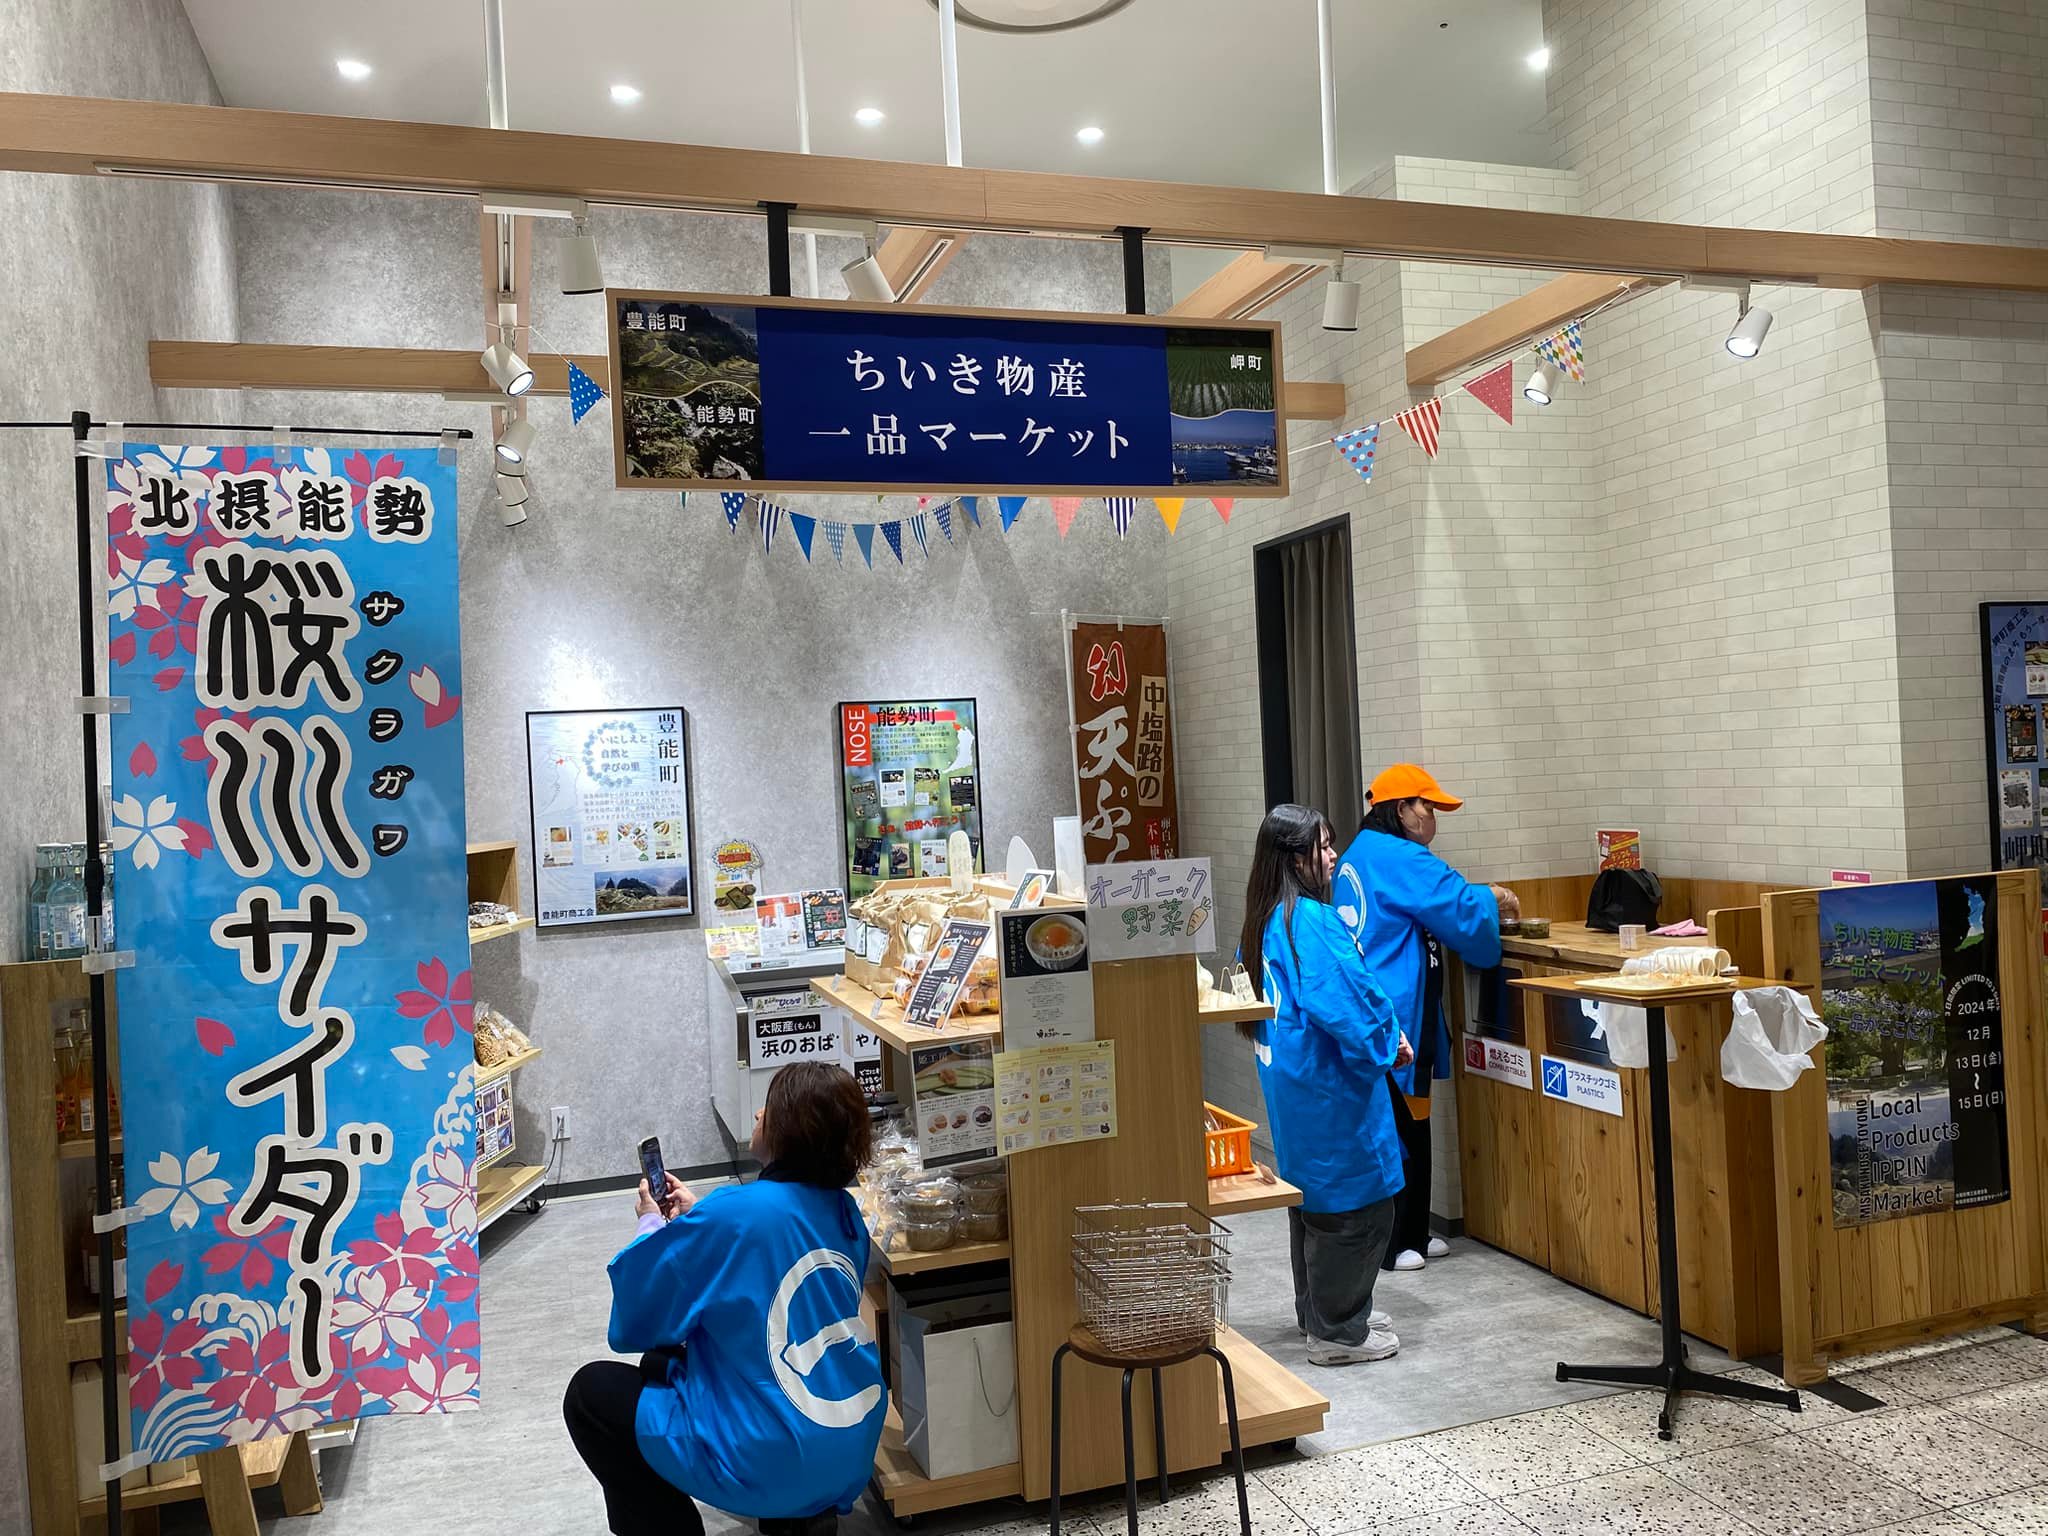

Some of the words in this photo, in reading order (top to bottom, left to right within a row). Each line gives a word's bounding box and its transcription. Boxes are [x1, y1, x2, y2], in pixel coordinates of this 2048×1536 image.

[626, 311, 688, 332] 豊能町
[846, 349, 1088, 399] ちいき物産
[1230, 354, 1263, 372] 岬町
[696, 404, 756, 426] 能勢町
[808, 413, 1129, 460] 一品マーケット
[140, 477, 427, 537] 北摂能勢
[366, 596, 407, 851] サクラガワ
[877, 706, 938, 727] 能勢町
[657, 713, 679, 784] 豊能町
[849, 710, 867, 763] NOSE
[1137, 682, 1165, 800] 中塩路の
[1090, 866, 1207, 908] オーガニック
[1121, 898, 1183, 940] 野菜
[1834, 923, 1915, 951] ちいき物産
[205, 553, 382, 1378] 桜川サイダー
[1833, 957, 1946, 984] 一品マーケット
[1958, 999, 1995, 1015] 2024年
[1967, 1026, 1990, 1040] 12月
[1489, 1048, 1524, 1067] 燃えるゴミ
[1489, 1062, 1527, 1078] COMBUSTIBLES
[1568, 1070, 1617, 1090] プラスチックゴミ
[1577, 1085, 1605, 1099] PLASTICS
[1871, 1092, 1921, 1119] Local
[1856, 1099, 1868, 1143] TOYONO
[1872, 1122, 1959, 1151] Products
[1873, 1155, 1926, 1182] IPPIN
[1874, 1185, 1942, 1213] Market
